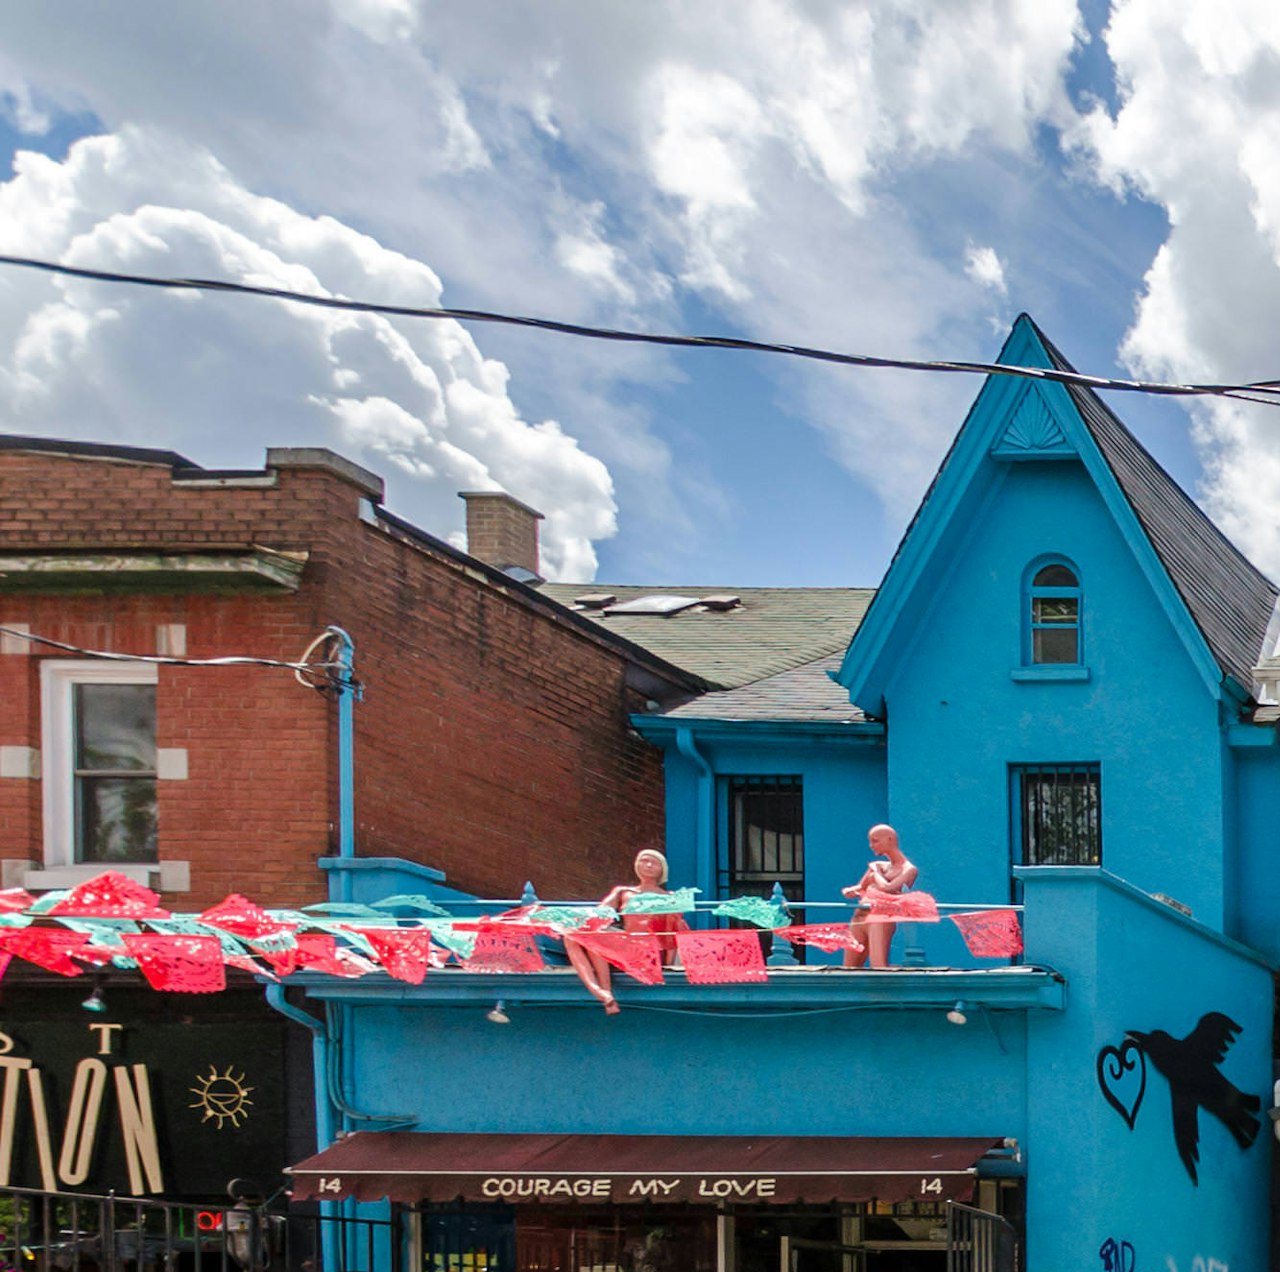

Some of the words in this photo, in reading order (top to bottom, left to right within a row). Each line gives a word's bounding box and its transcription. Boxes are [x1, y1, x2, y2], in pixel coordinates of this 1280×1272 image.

[319, 1178, 342, 1193] 14
[482, 1178, 612, 1197] COURAGE
[628, 1179, 680, 1196] MY
[699, 1179, 776, 1197] LOVE
[921, 1179, 943, 1195] 14
